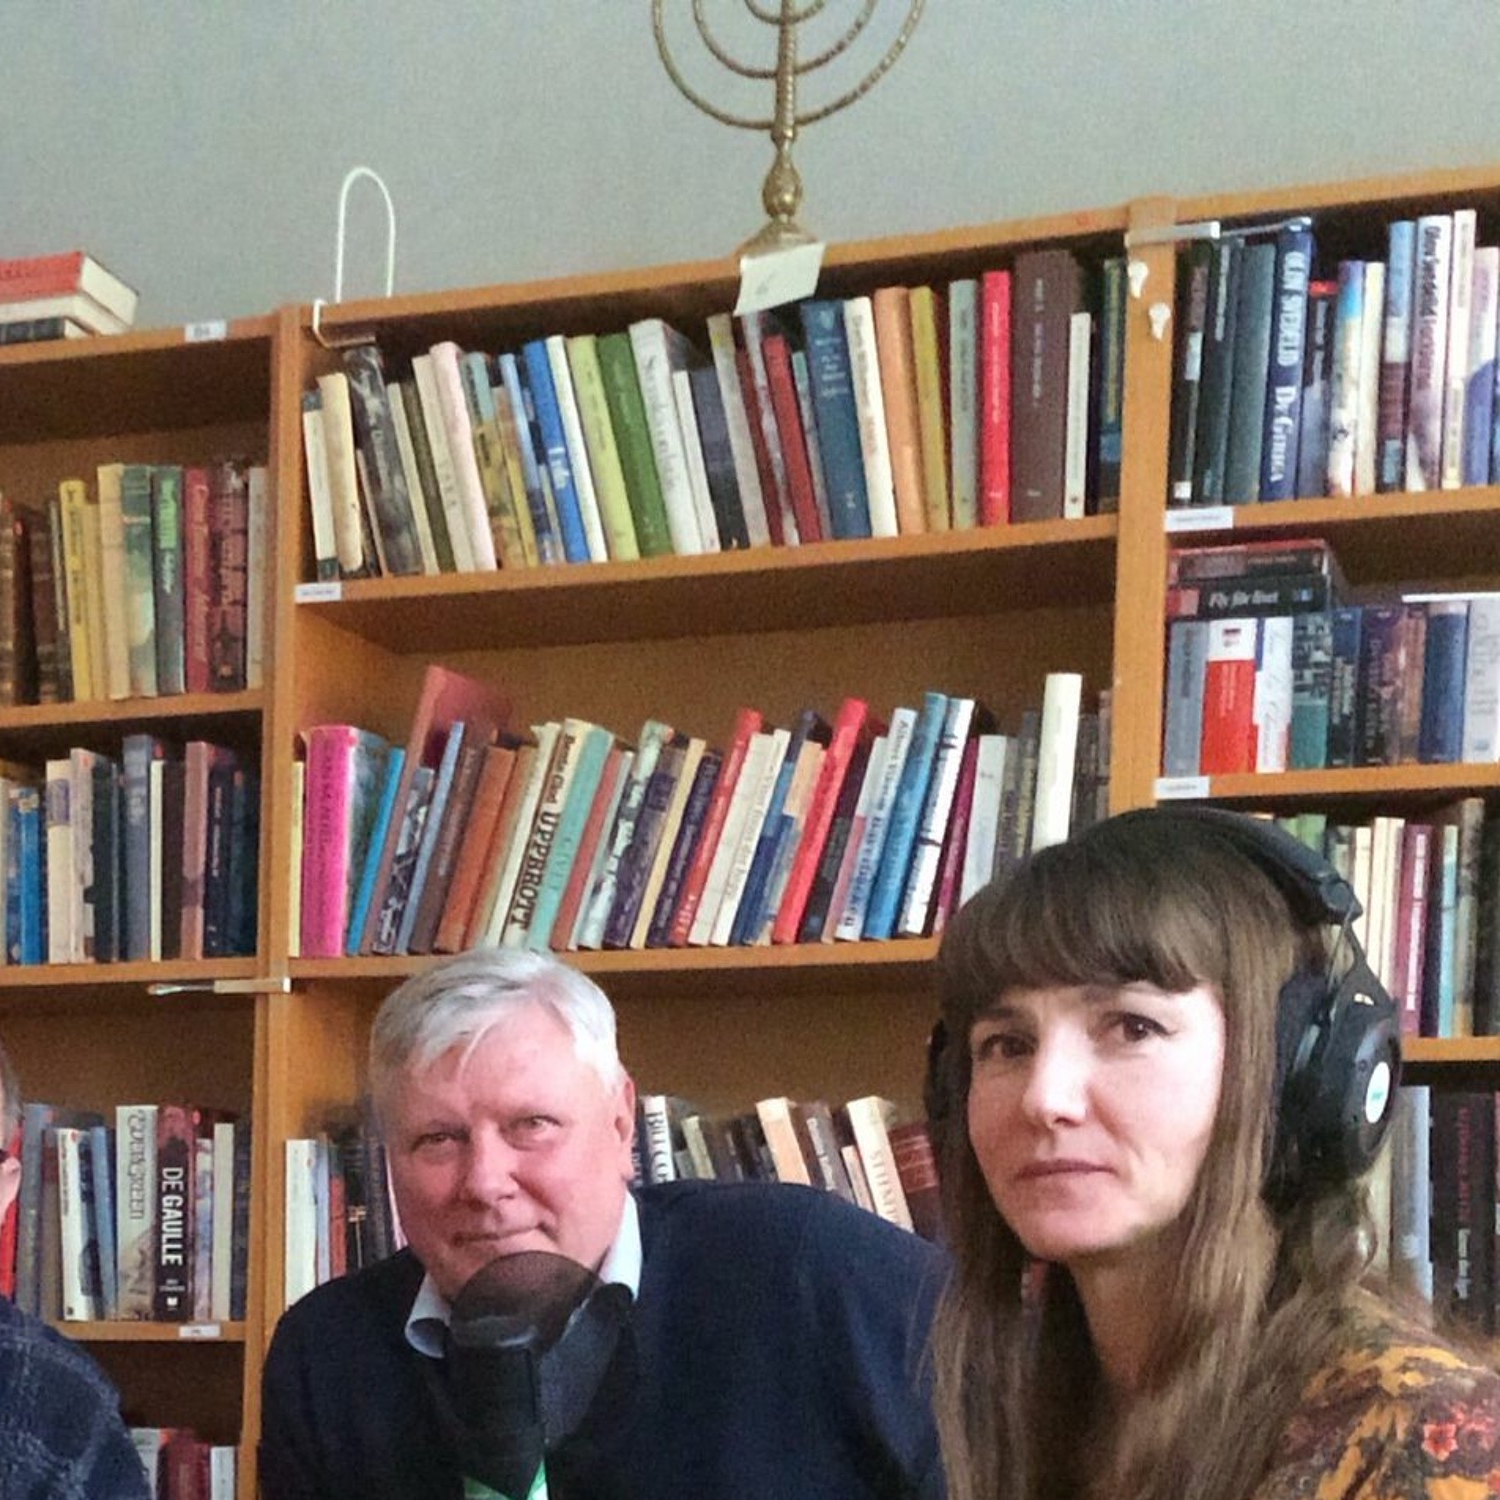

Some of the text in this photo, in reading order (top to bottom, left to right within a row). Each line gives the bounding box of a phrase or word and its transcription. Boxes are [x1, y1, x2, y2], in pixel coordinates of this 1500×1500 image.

[510, 811, 562, 930] UPPBROTT
[161, 1167, 184, 1267] DE GAULLE
